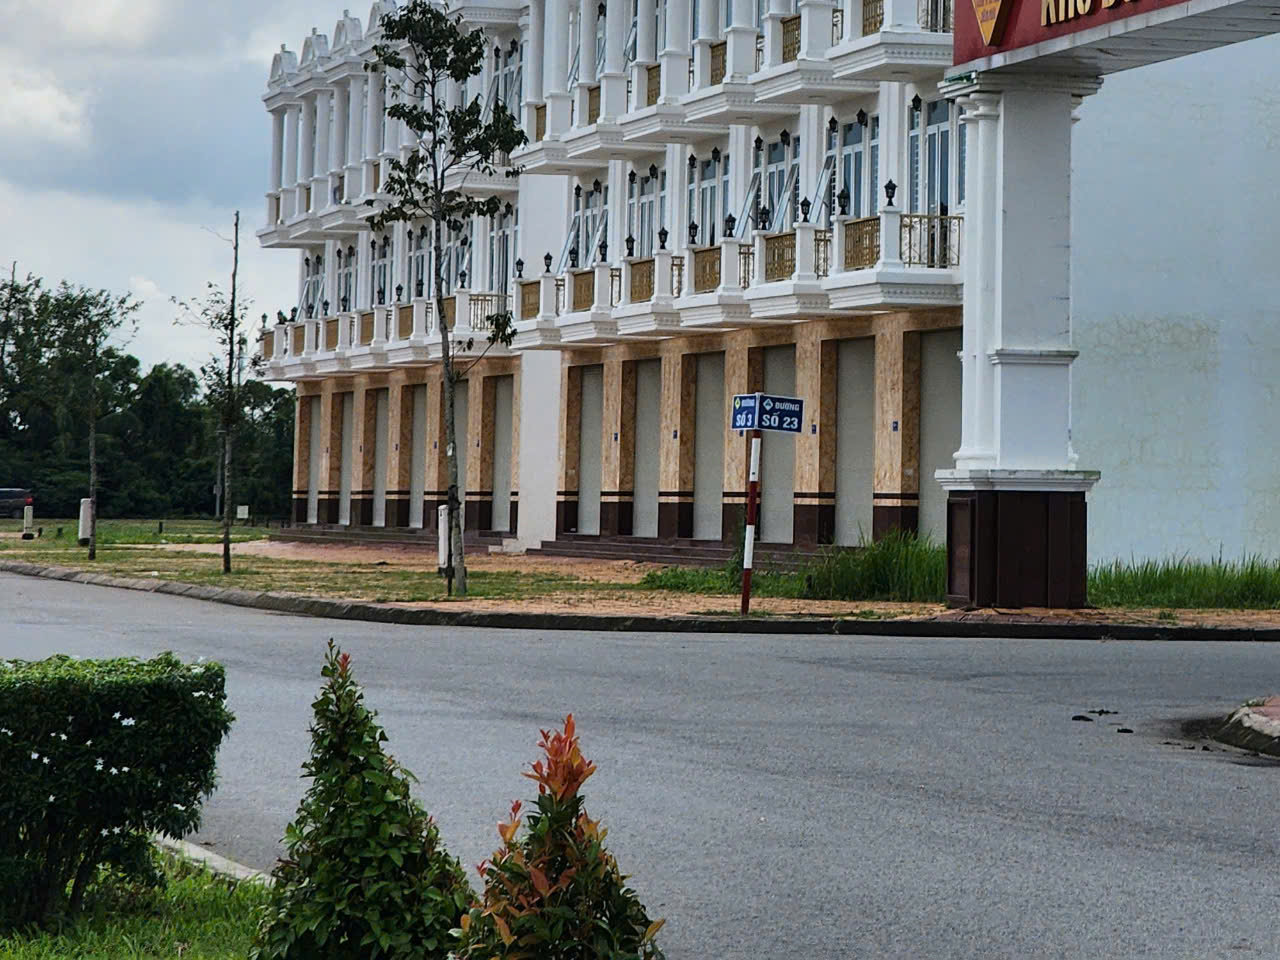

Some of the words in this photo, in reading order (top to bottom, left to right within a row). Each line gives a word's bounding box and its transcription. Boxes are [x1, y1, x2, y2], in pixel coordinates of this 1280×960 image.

[736, 410, 747, 426] SỐ
[747, 414, 752, 426] 3
[762, 411, 780, 427] SỐ
[783, 417, 798, 429] 23
